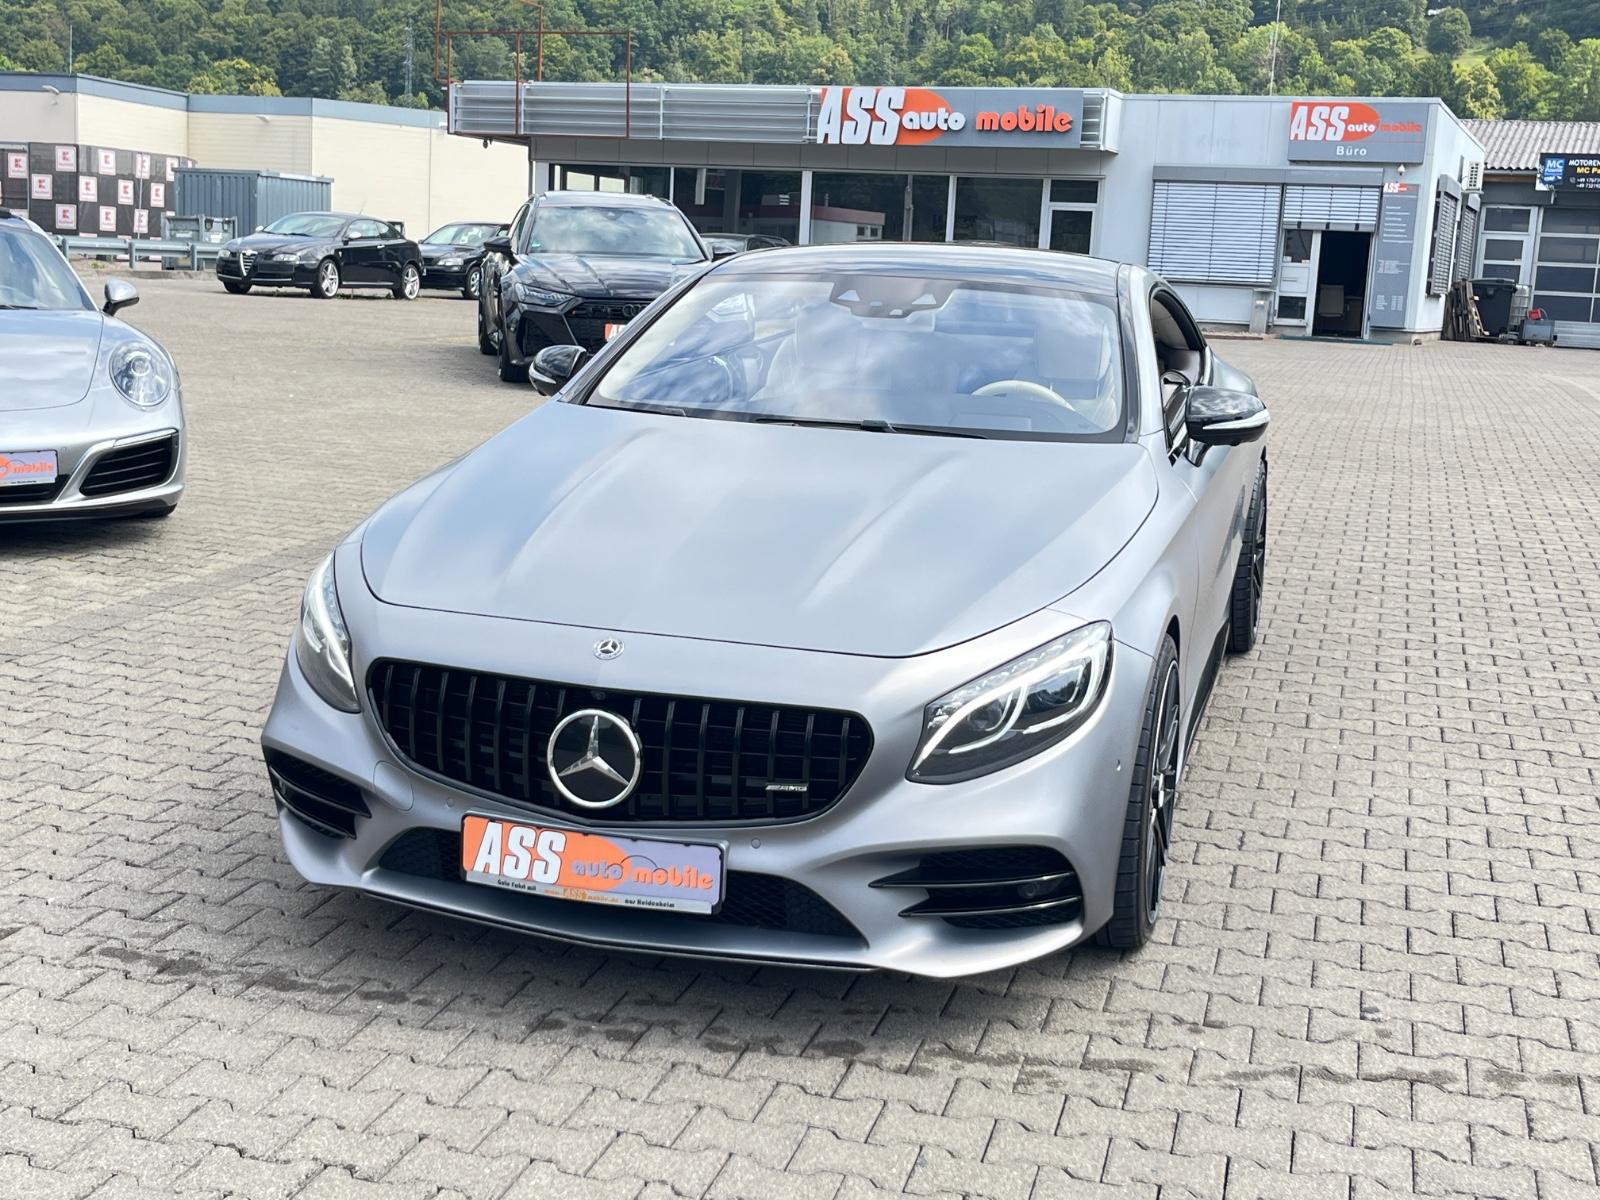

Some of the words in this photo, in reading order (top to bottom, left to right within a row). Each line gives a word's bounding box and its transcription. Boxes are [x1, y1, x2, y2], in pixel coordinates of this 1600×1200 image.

[817, 88, 905, 145] ASS
[902, 107, 967, 131] auto
[975, 103, 1073, 133] mobile
[1290, 105, 1349, 141] ASS
[1347, 122, 1376, 133] auto
[1336, 145, 1367, 156] Büro
[1547, 160, 1564, 168] MC
[1383, 183, 1399, 193] ASS
[472, 821, 567, 884] ASS
[572, 859, 623, 880] auto
[632, 864, 713, 890] mobile
